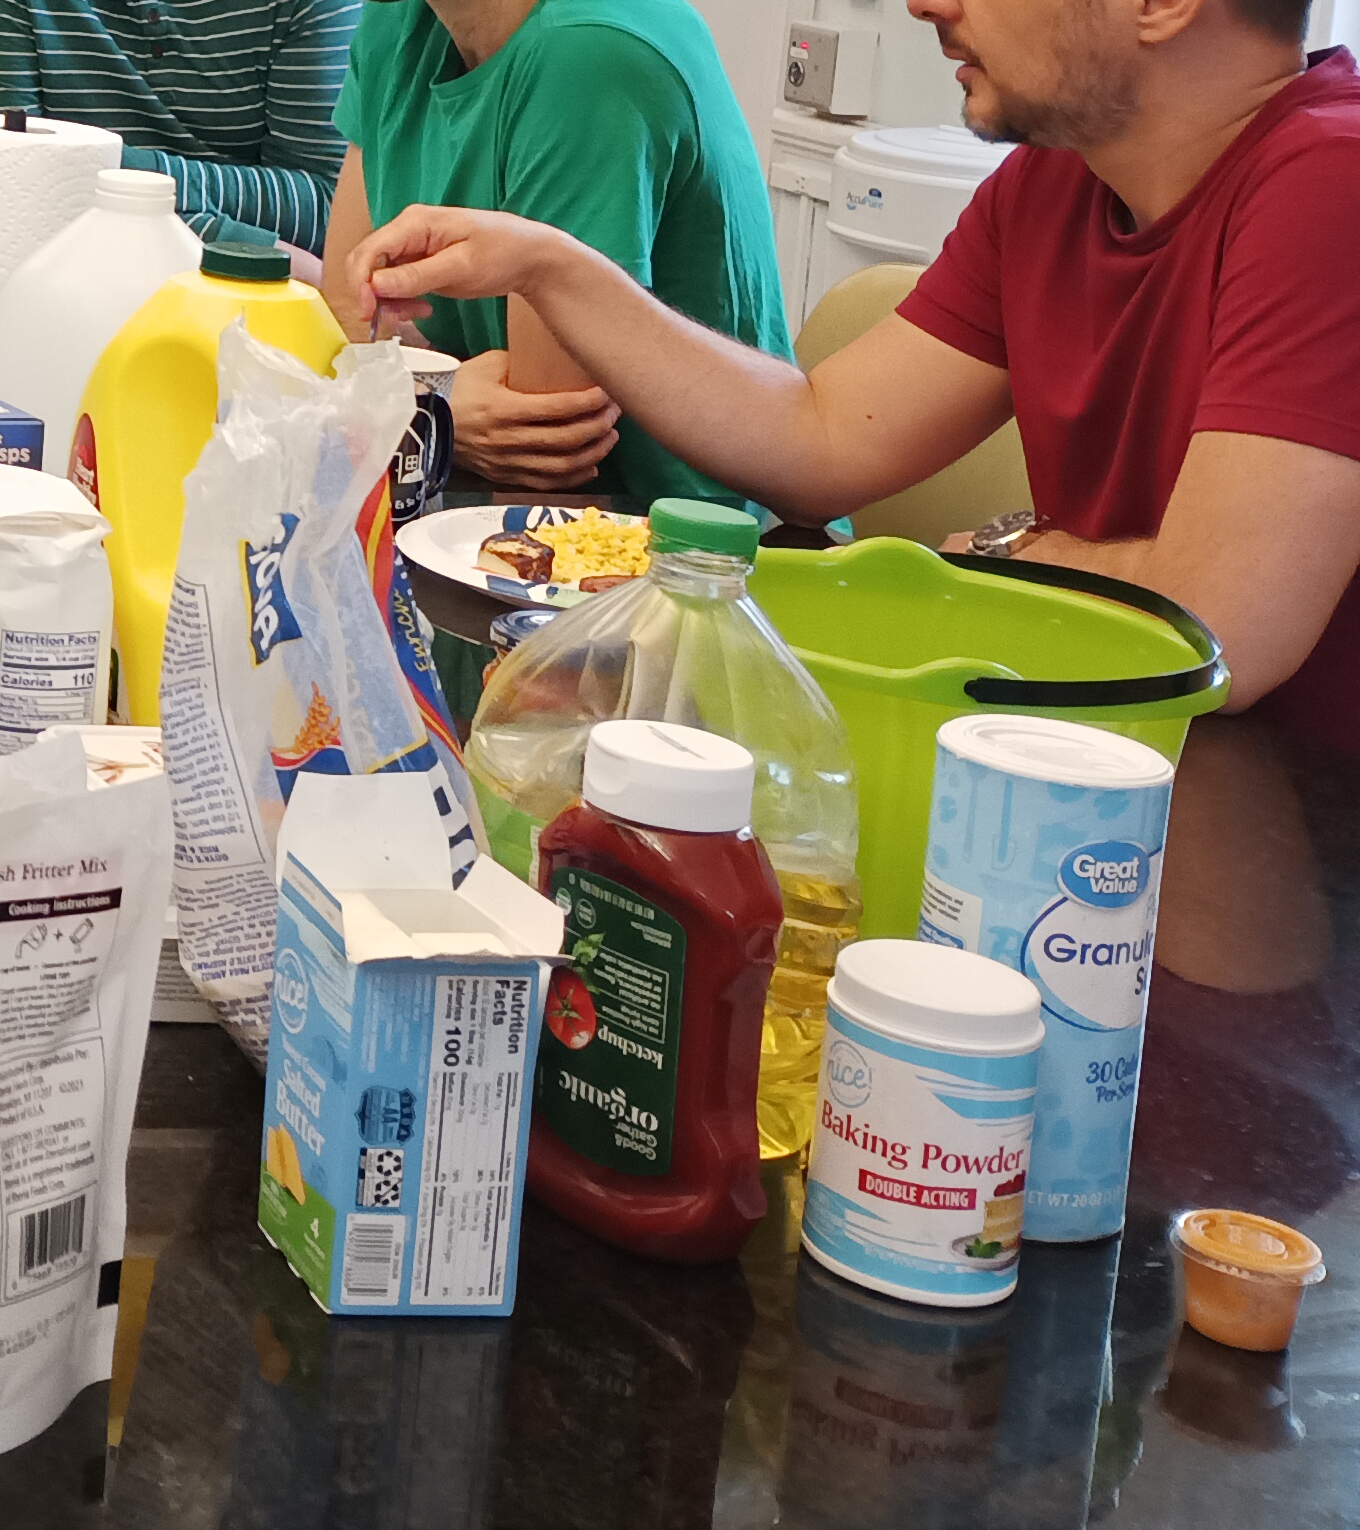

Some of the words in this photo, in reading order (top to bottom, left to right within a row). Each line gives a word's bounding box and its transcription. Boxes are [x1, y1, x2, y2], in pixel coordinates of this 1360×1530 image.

[5, 633, 64, 646] Nutrition
[68, 635, 97, 645] Facts
[1, 674, 53, 687] Calories
[72, 673, 93, 686] 110
[198, 845, 219, 854] RICE
[22, 862, 74, 880] Fritter
[79, 856, 108, 875] Mix
[1072, 854, 1139, 879] Great
[1090, 876, 1138, 894] Value
[8, 900, 50, 917] Cooking
[229, 966, 250, 976] PARA
[454, 979, 466, 1022] Calories
[492, 980, 510, 1025] Facts
[508, 980, 528, 1054] Nutrition
[444, 1026, 461, 1067] 100
[598, 1024, 663, 1070] ketchup
[828, 1059, 873, 1091] nice!
[1086, 1060, 1112, 1084] 30
[283, 1058, 321, 1118] Salted
[559, 1070, 658, 1132] organic
[1096, 1086, 1117, 1103] Per
[276, 1078, 325, 1157] Butter
[614, 1122, 658, 1148] Gather
[821, 1099, 912, 1170] Baking
[921, 1142, 1024, 1175] Powder
[866, 1175, 918, 1204] DOUBLE
[920, 1189, 969, 1208] ACTING
[1028, 1191, 1044, 1206] ET
[1048, 1193, 1070, 1207] WT
[1071, 1194, 1087, 1207] 20
